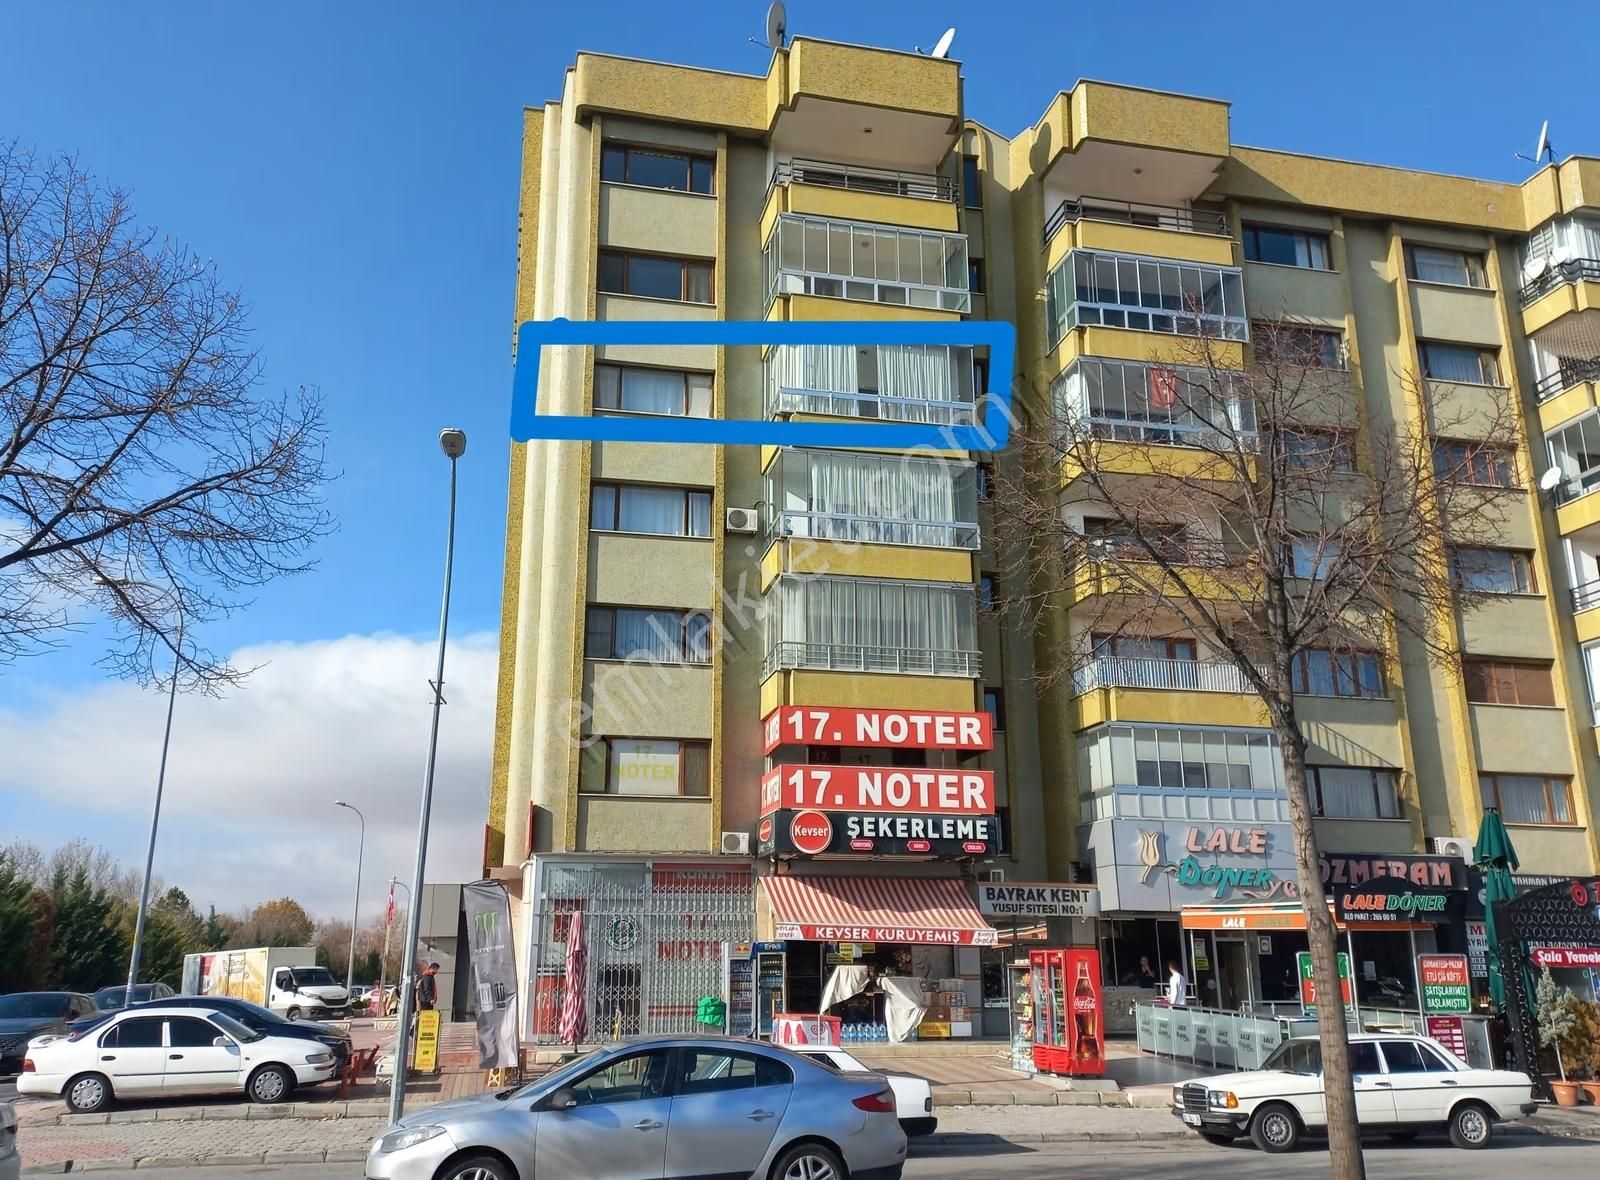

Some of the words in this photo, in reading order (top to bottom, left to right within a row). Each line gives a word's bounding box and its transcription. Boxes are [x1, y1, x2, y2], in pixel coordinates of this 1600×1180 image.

[788, 711, 842, 741] 17.
[856, 714, 983, 745] NOTER
[788, 770, 844, 805] 17.
[858, 773, 988, 808] NOTER
[795, 825, 829, 837] Kevser
[847, 817, 989, 839] ŞEKERLEME
[1187, 827, 1268, 853] LALE
[1179, 855, 1272, 898] DÖNER
[986, 887, 1046, 901] BAYRAK
[1050, 888, 1090, 902] KENT
[1343, 894, 1387, 911] LALE
[1386, 891, 1447, 917] DÖNER
[992, 903, 1024, 913] YUSUF
[1026, 903, 1057, 914] SİTESİ
[1222, 918, 1246, 928] LALE
[815, 927, 870, 940] KEVSER
[875, 929, 960, 943] KURUYEMİŞ
[657, 941, 722, 961] NOTE
